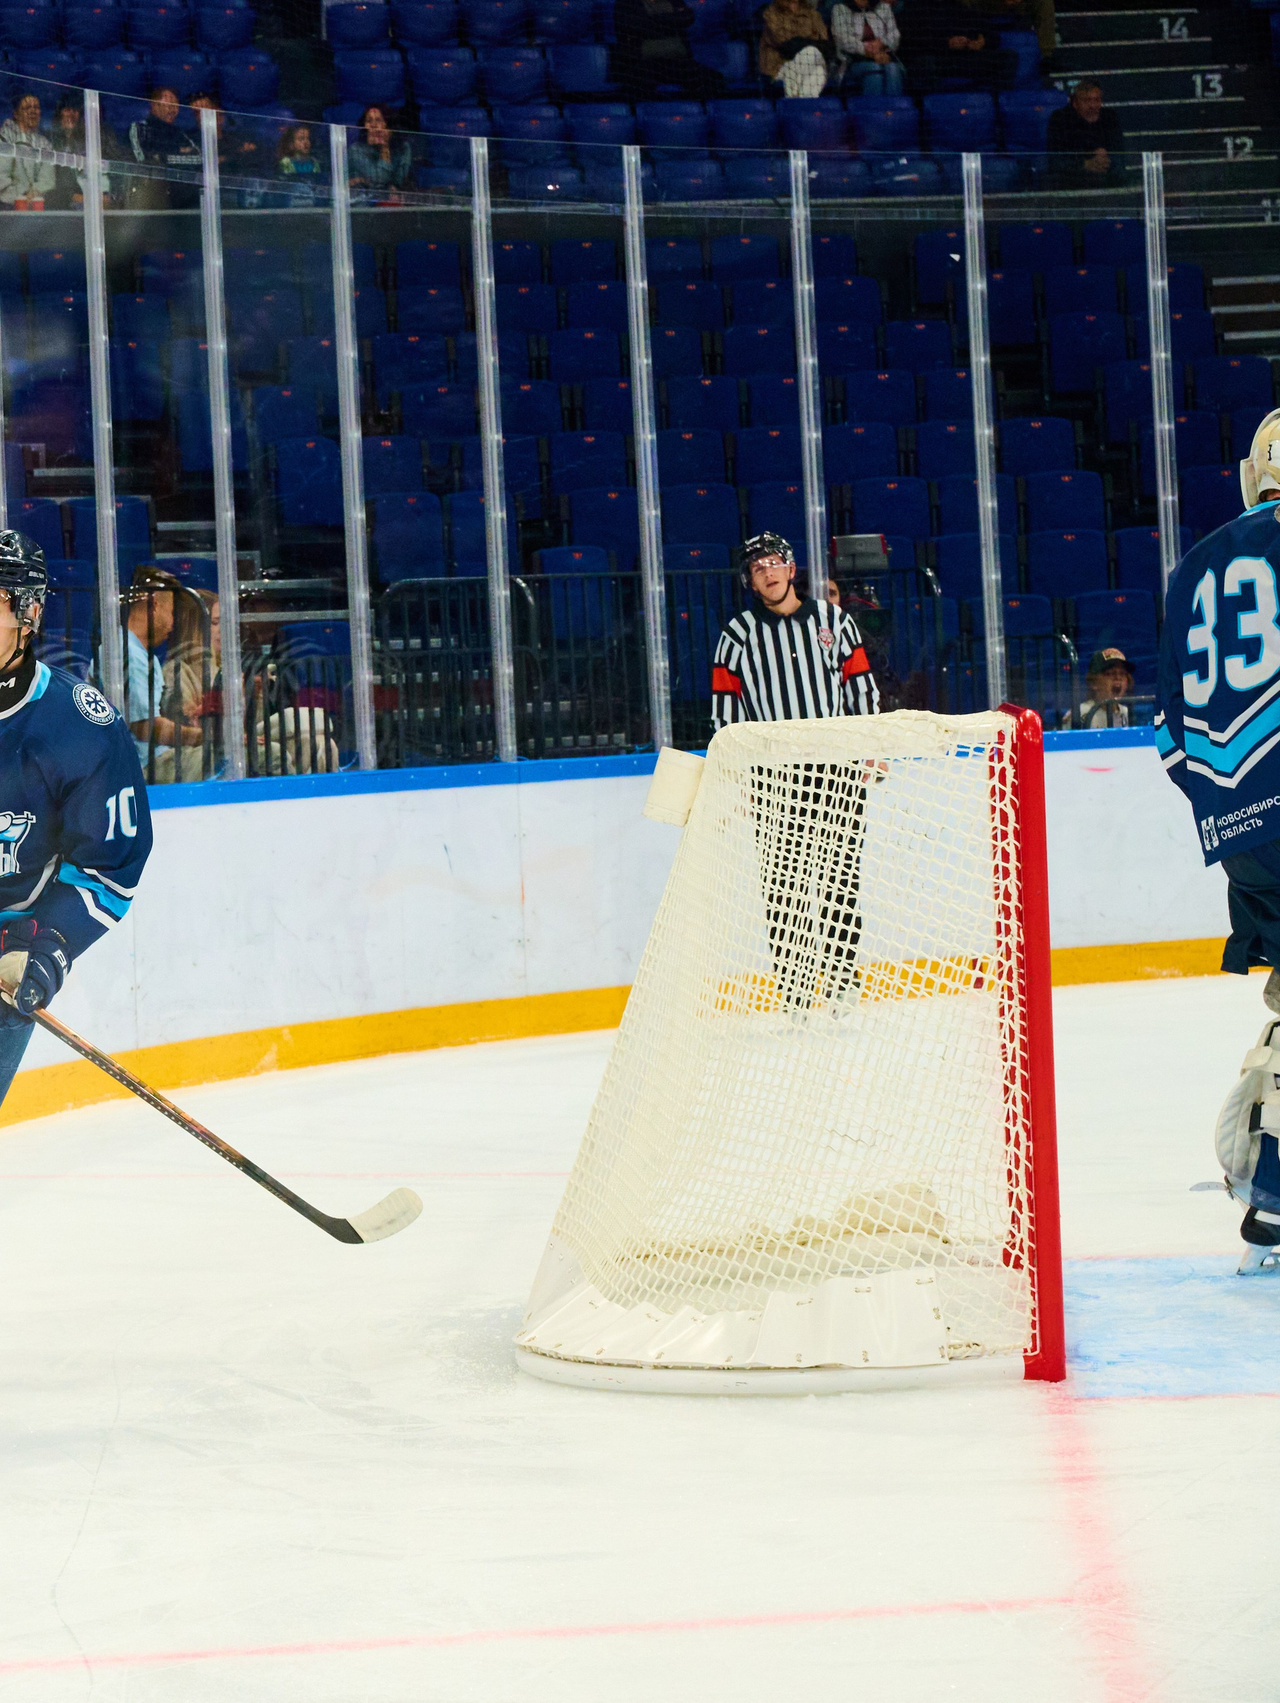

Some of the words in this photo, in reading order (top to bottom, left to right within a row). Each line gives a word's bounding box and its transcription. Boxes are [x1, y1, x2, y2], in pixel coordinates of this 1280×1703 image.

[1158, 17, 1190, 41] 14
[1191, 73, 1224, 99] 13
[1223, 136, 1254, 160] 12
[1182, 555, 1280, 708] 33
[104, 785, 138, 842] 10
[1220, 817, 1263, 840] ОБЛАСТЬ
